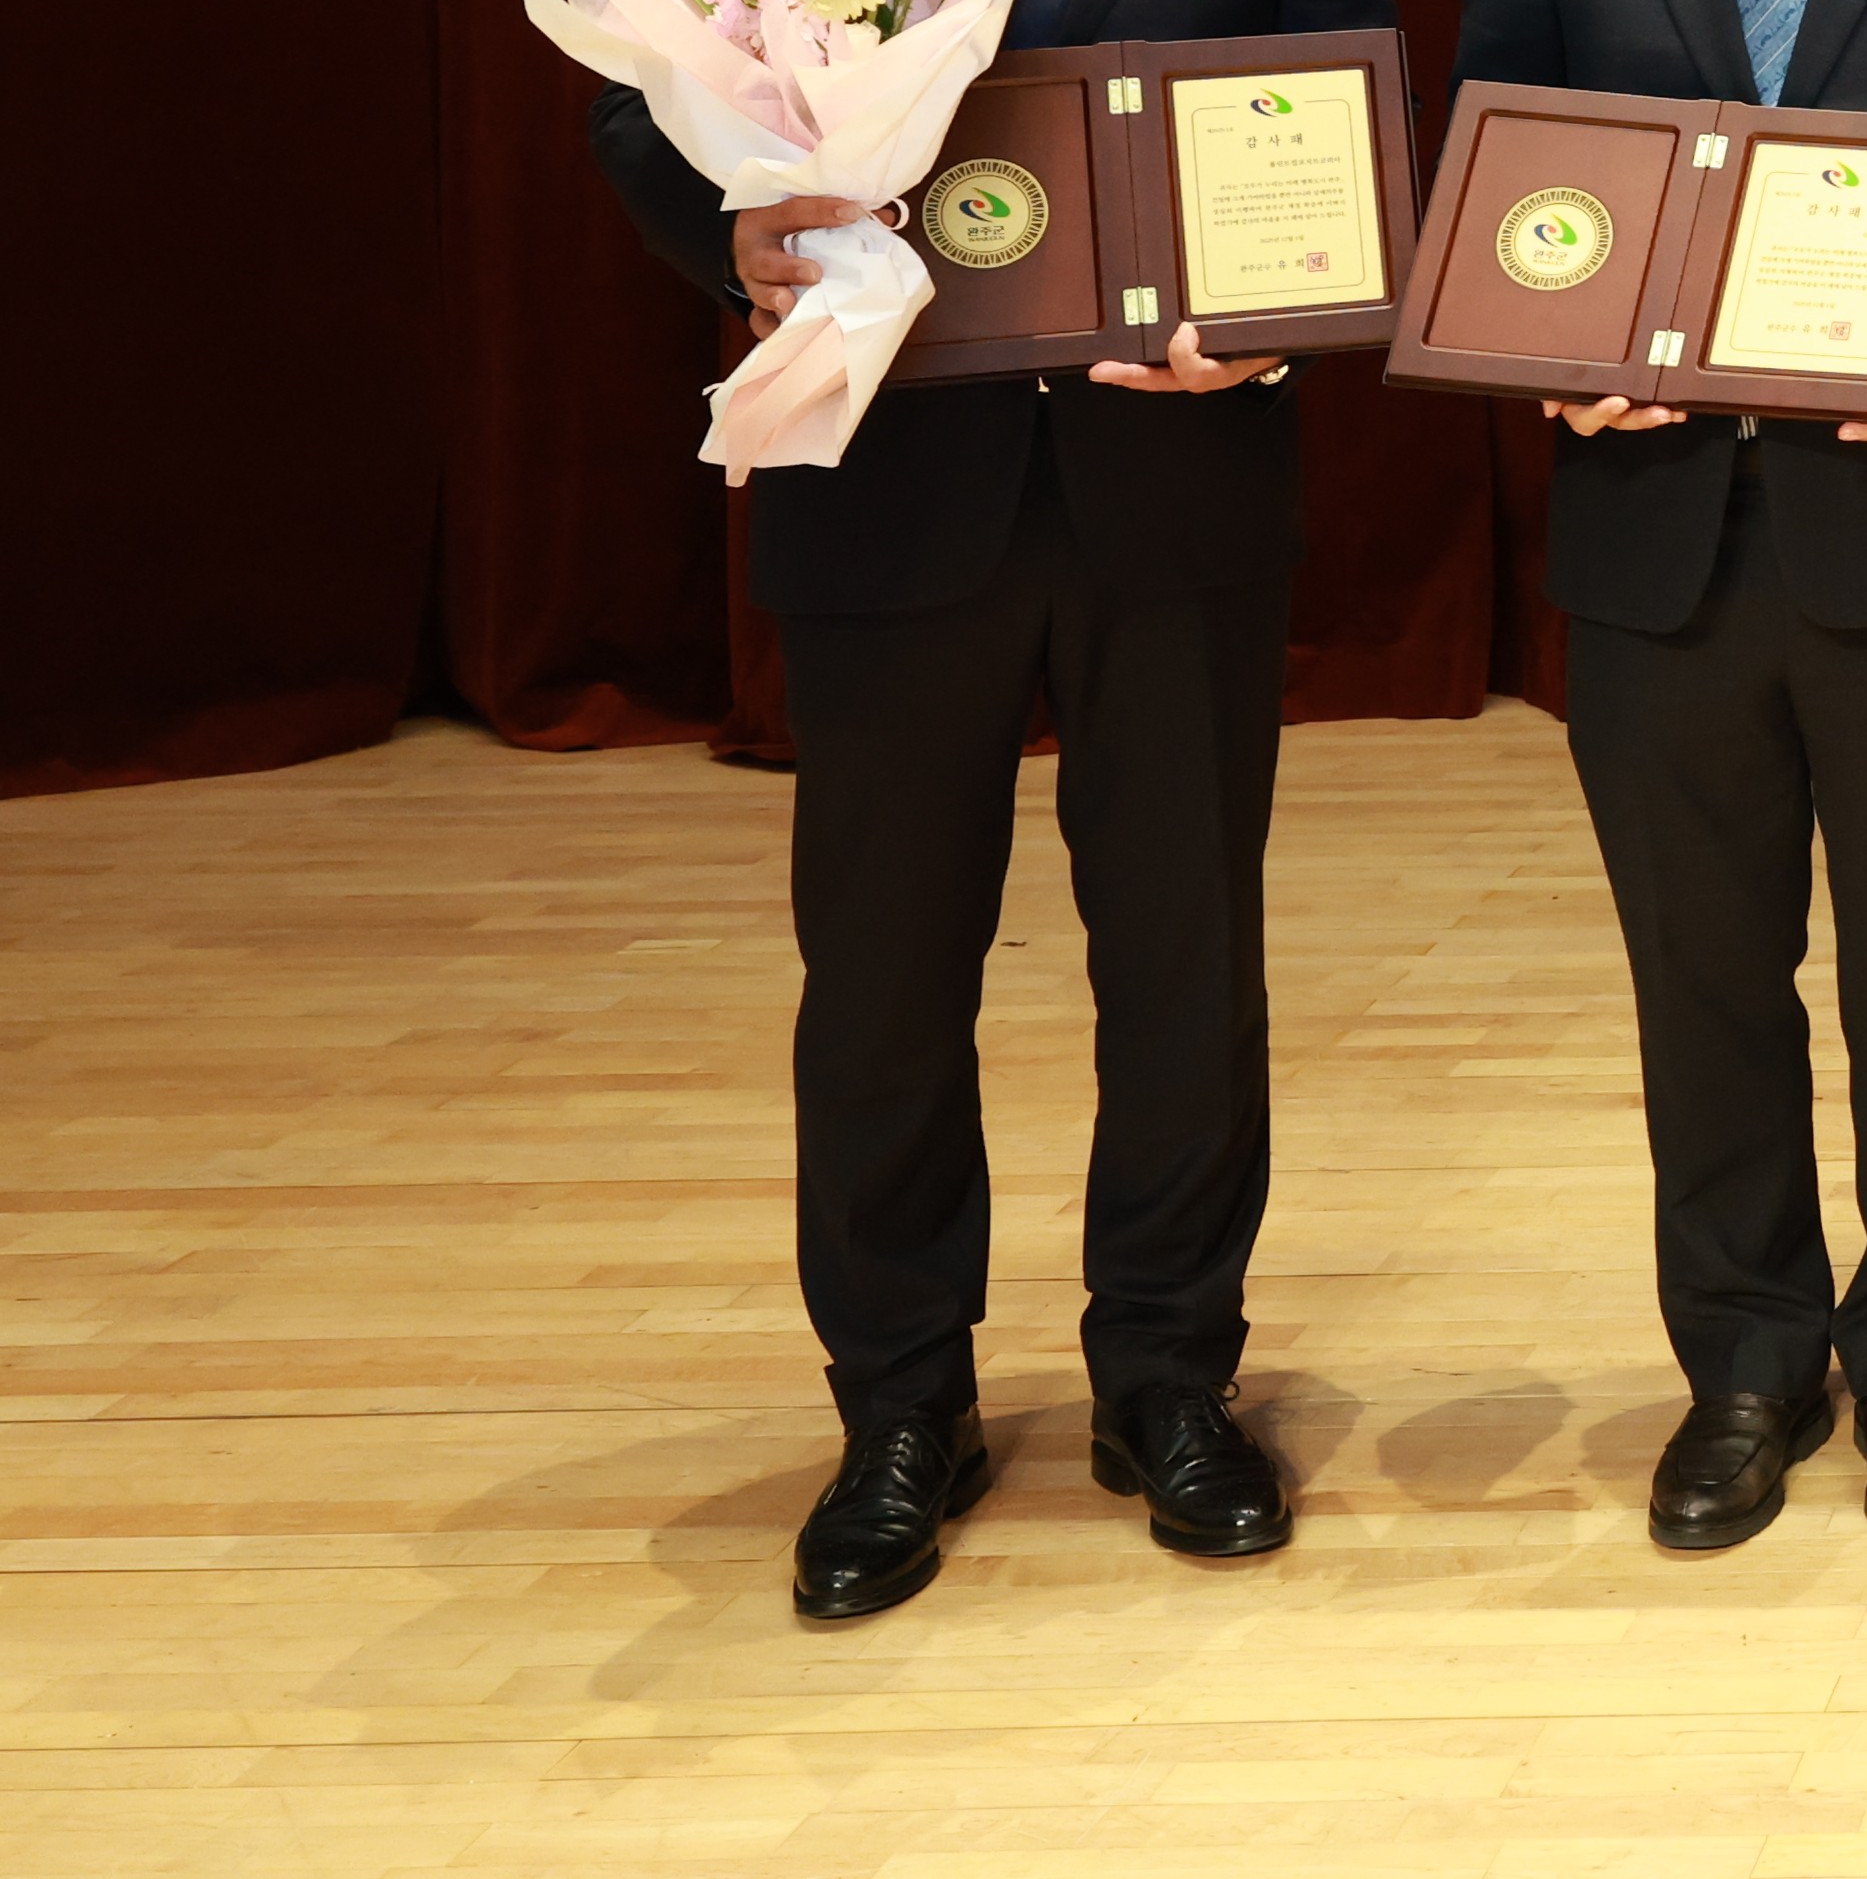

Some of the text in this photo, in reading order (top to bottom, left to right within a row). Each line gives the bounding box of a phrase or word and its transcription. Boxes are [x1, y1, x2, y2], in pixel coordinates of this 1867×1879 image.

[1246, 133, 1302, 149] 감 사 패
[1808, 203, 1818, 216] 감
[1829, 205, 1839, 216] 사
[967, 225, 1005, 236] 완주군
[1277, 259, 1286, 270] 유
